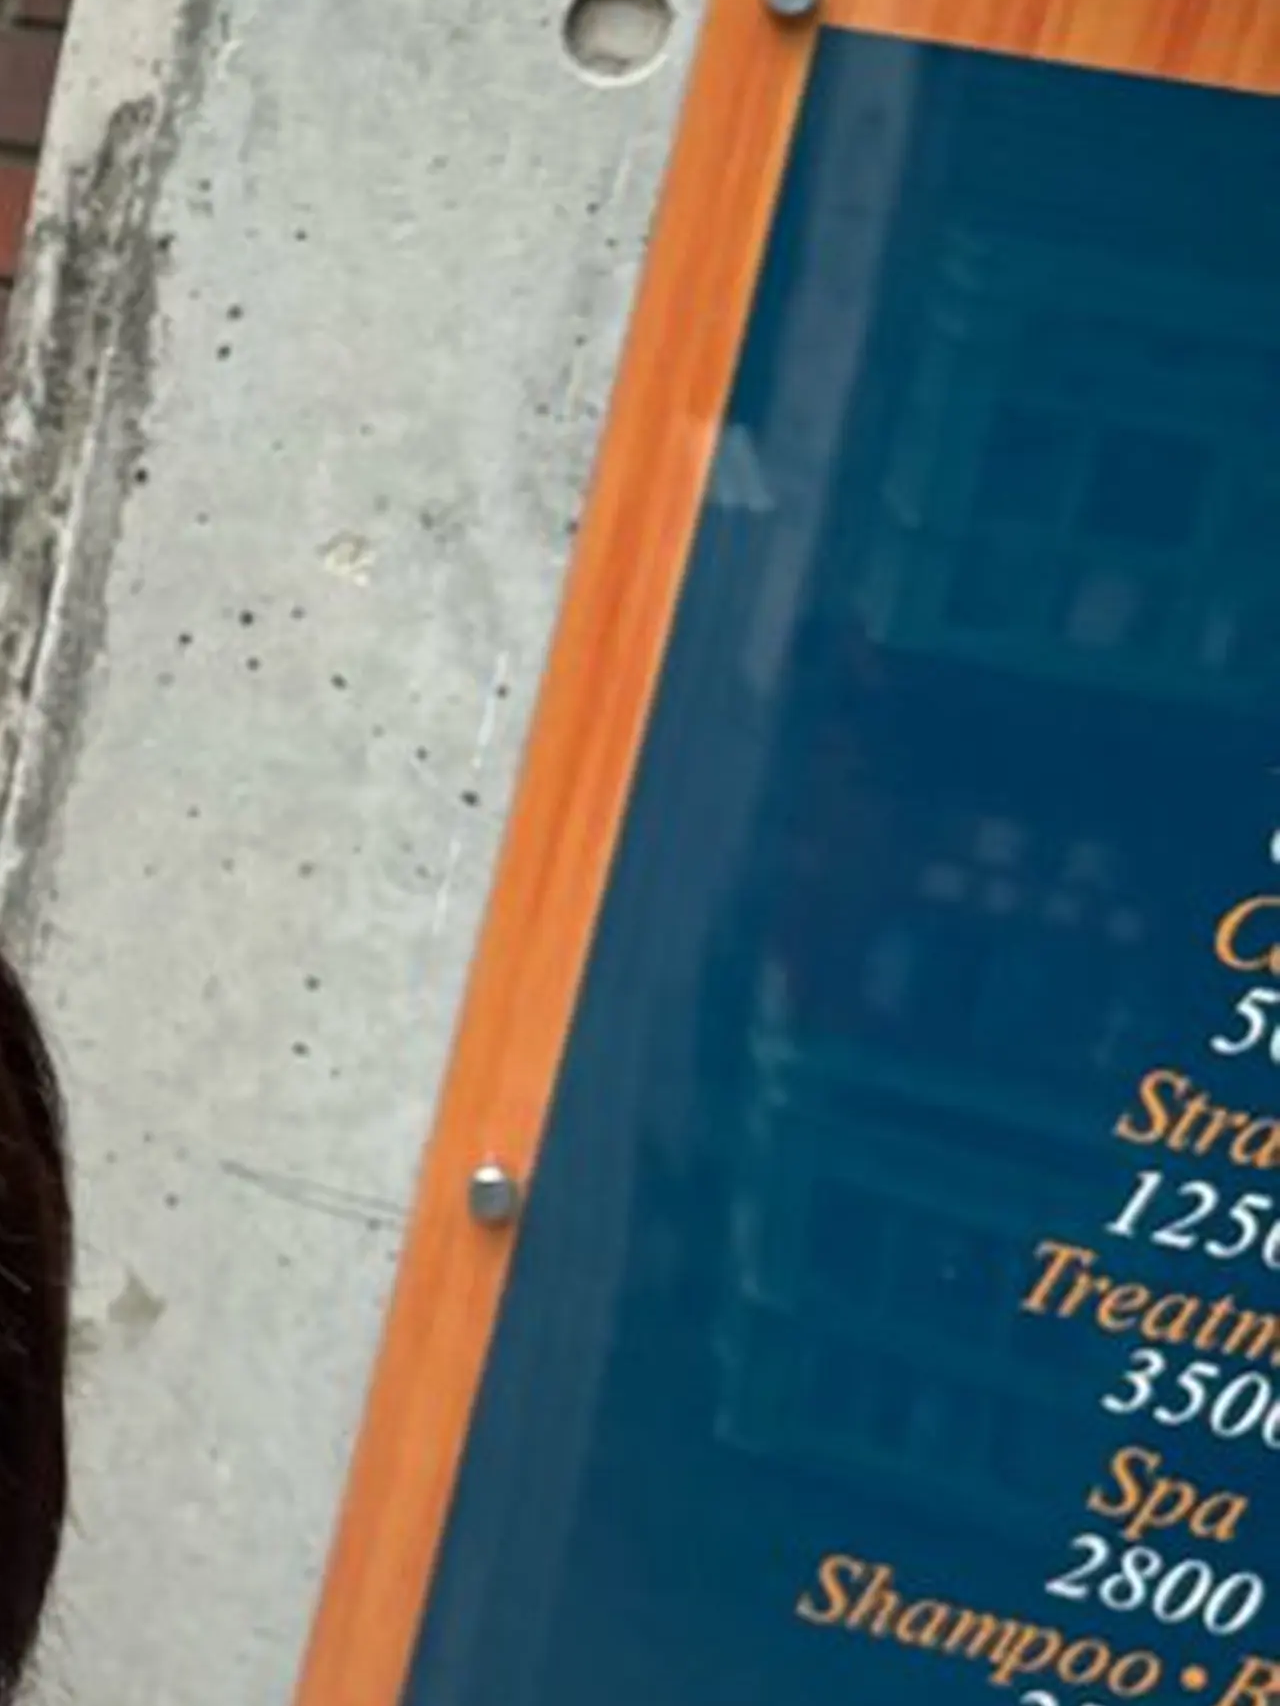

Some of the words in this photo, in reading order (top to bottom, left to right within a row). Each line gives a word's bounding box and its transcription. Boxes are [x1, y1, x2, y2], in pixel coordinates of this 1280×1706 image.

[1214, 895, 1280, 975] C
[1209, 988, 1280, 1063] 5
[1087, 1446, 1248, 1541] Spa
[1044, 1532, 1265, 1637] 2800
